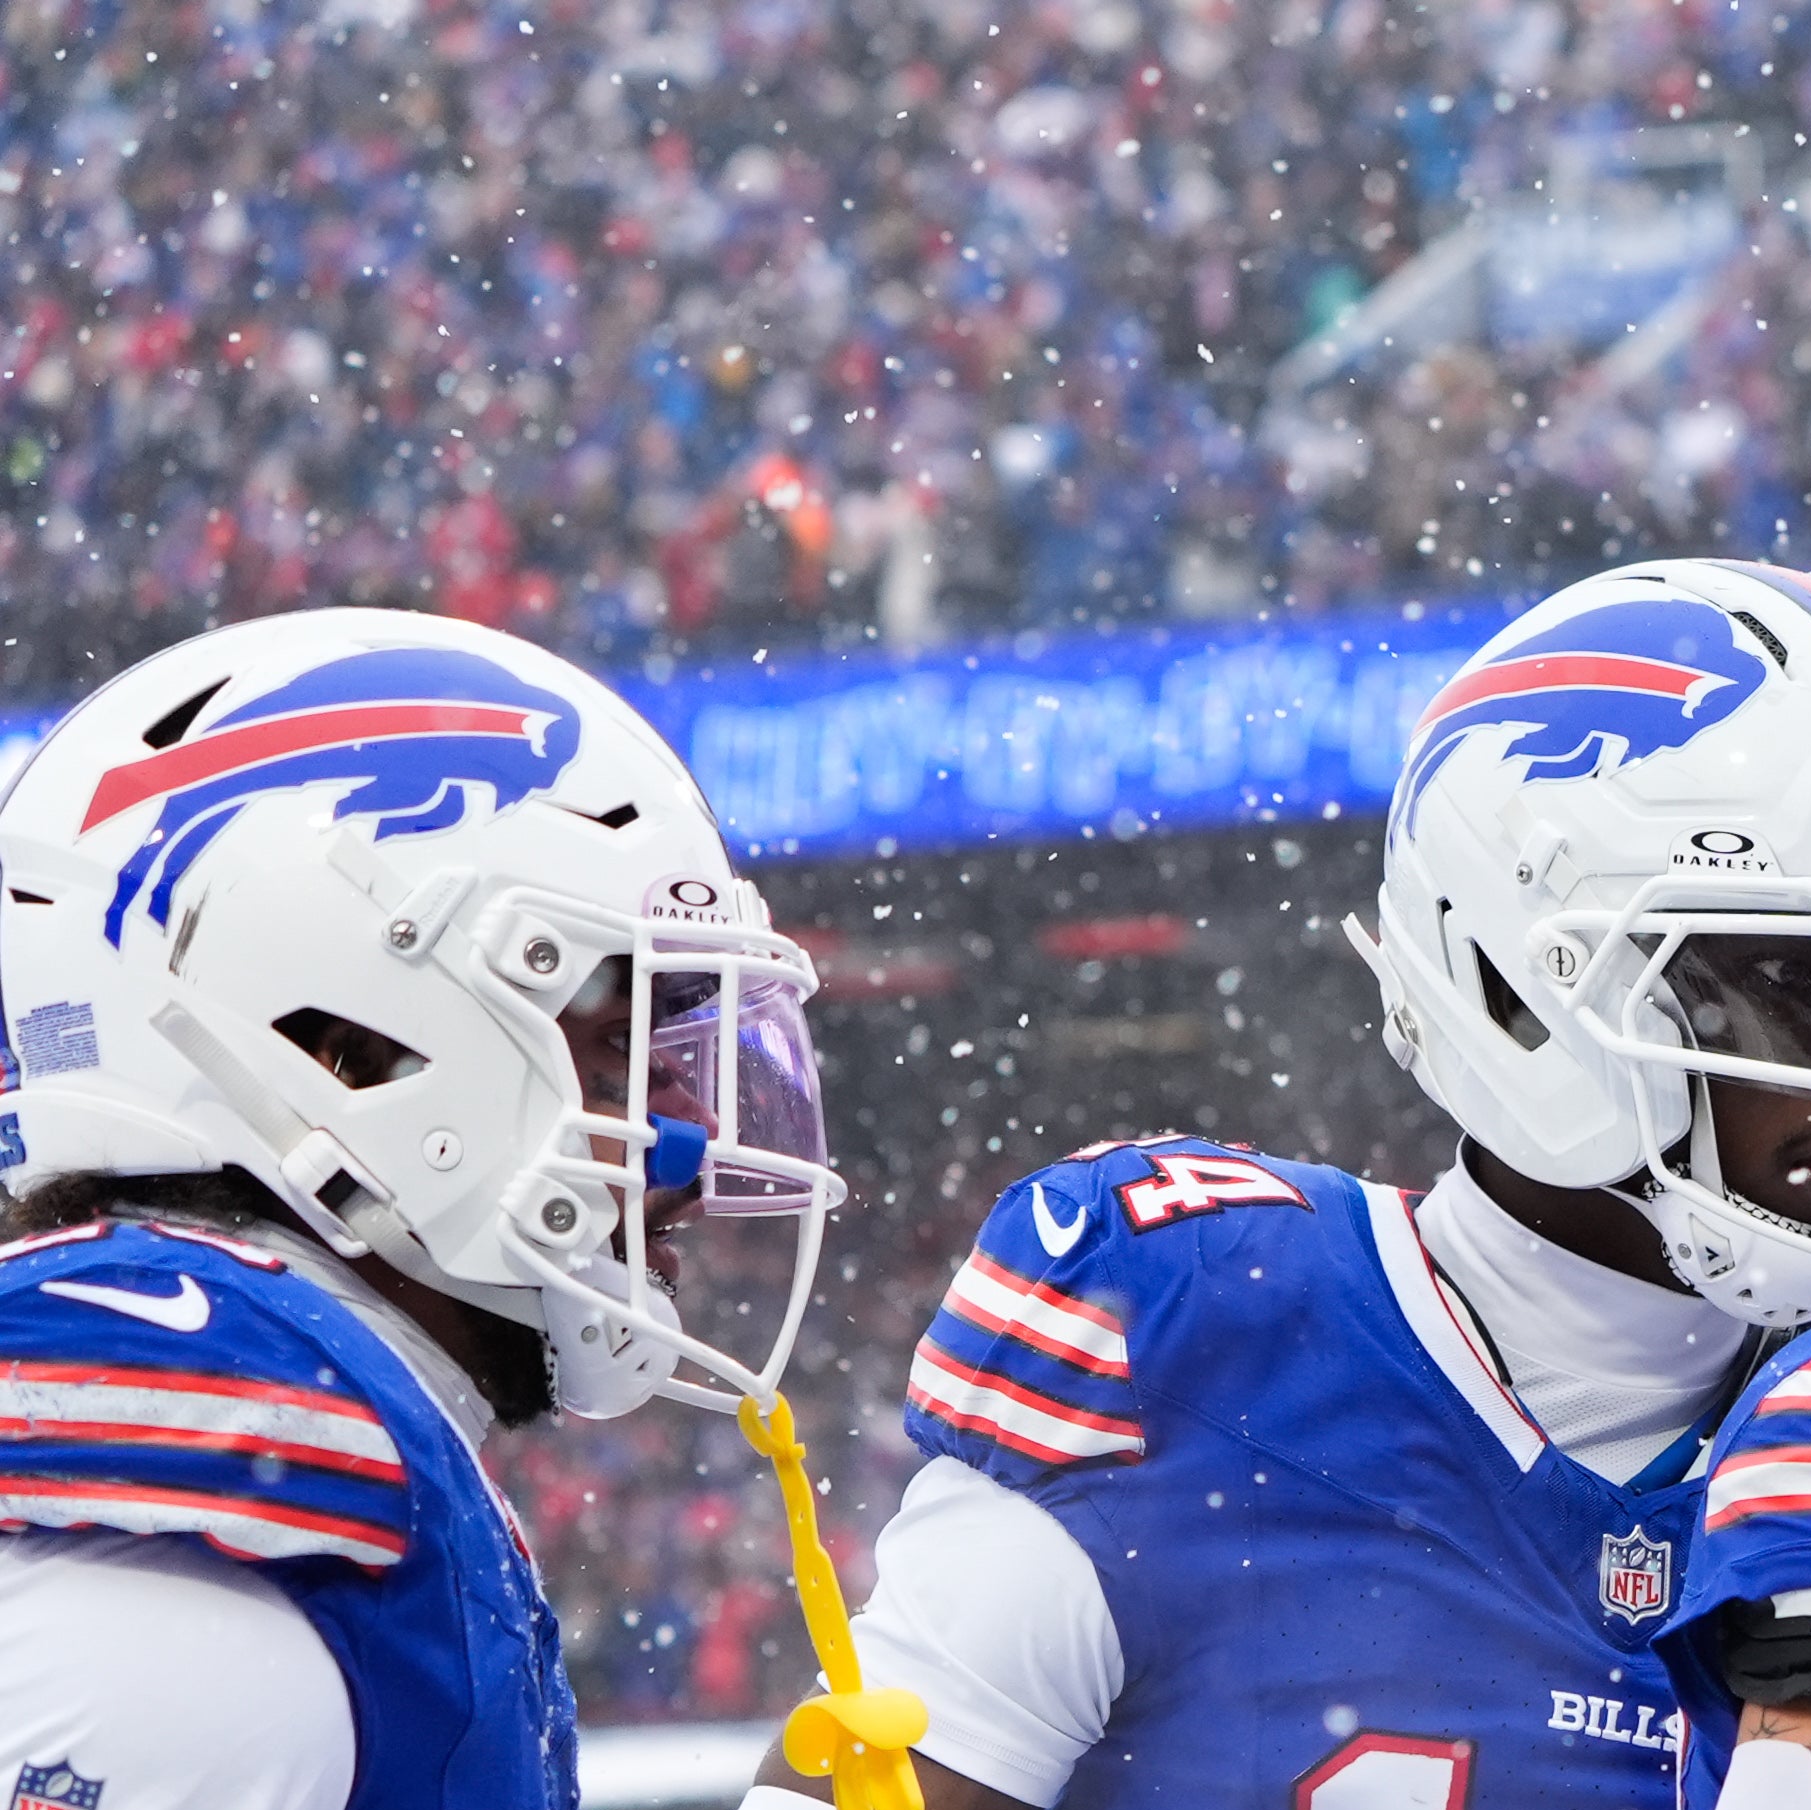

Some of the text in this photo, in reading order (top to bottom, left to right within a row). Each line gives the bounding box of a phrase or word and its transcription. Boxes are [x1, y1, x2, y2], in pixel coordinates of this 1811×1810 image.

[1673, 854, 1768, 871] OAKLEY
[652, 905, 729, 925] OAKLEY
[1612, 1570, 1660, 1608] NFL
